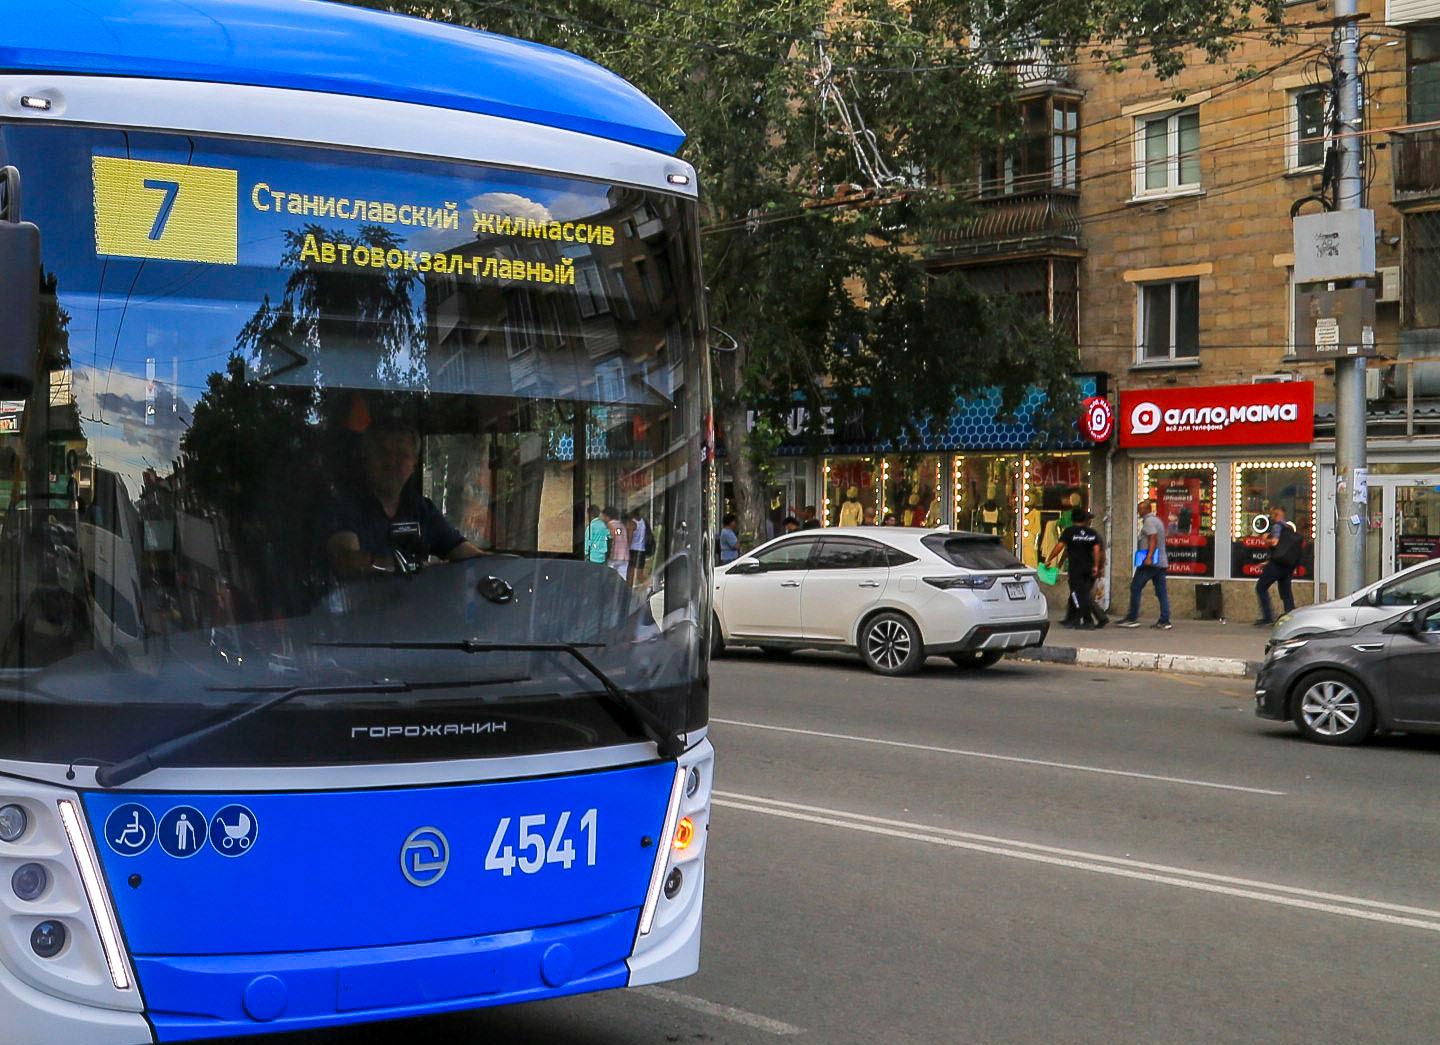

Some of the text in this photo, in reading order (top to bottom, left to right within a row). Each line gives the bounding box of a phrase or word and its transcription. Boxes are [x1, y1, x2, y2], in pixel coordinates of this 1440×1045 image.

[143, 179, 615, 245] 7 Станиславский жилмассив
[300, 233, 575, 285] Автовокзал-главный
[1192, 424, 1223, 432] телефона
[1033, 464, 1080, 486] SALE
[1169, 563, 1191, 571] ТЁКЛА
[351, 721, 507, 738] ГОРОЖАНИН
[484, 808, 598, 876] 4541
